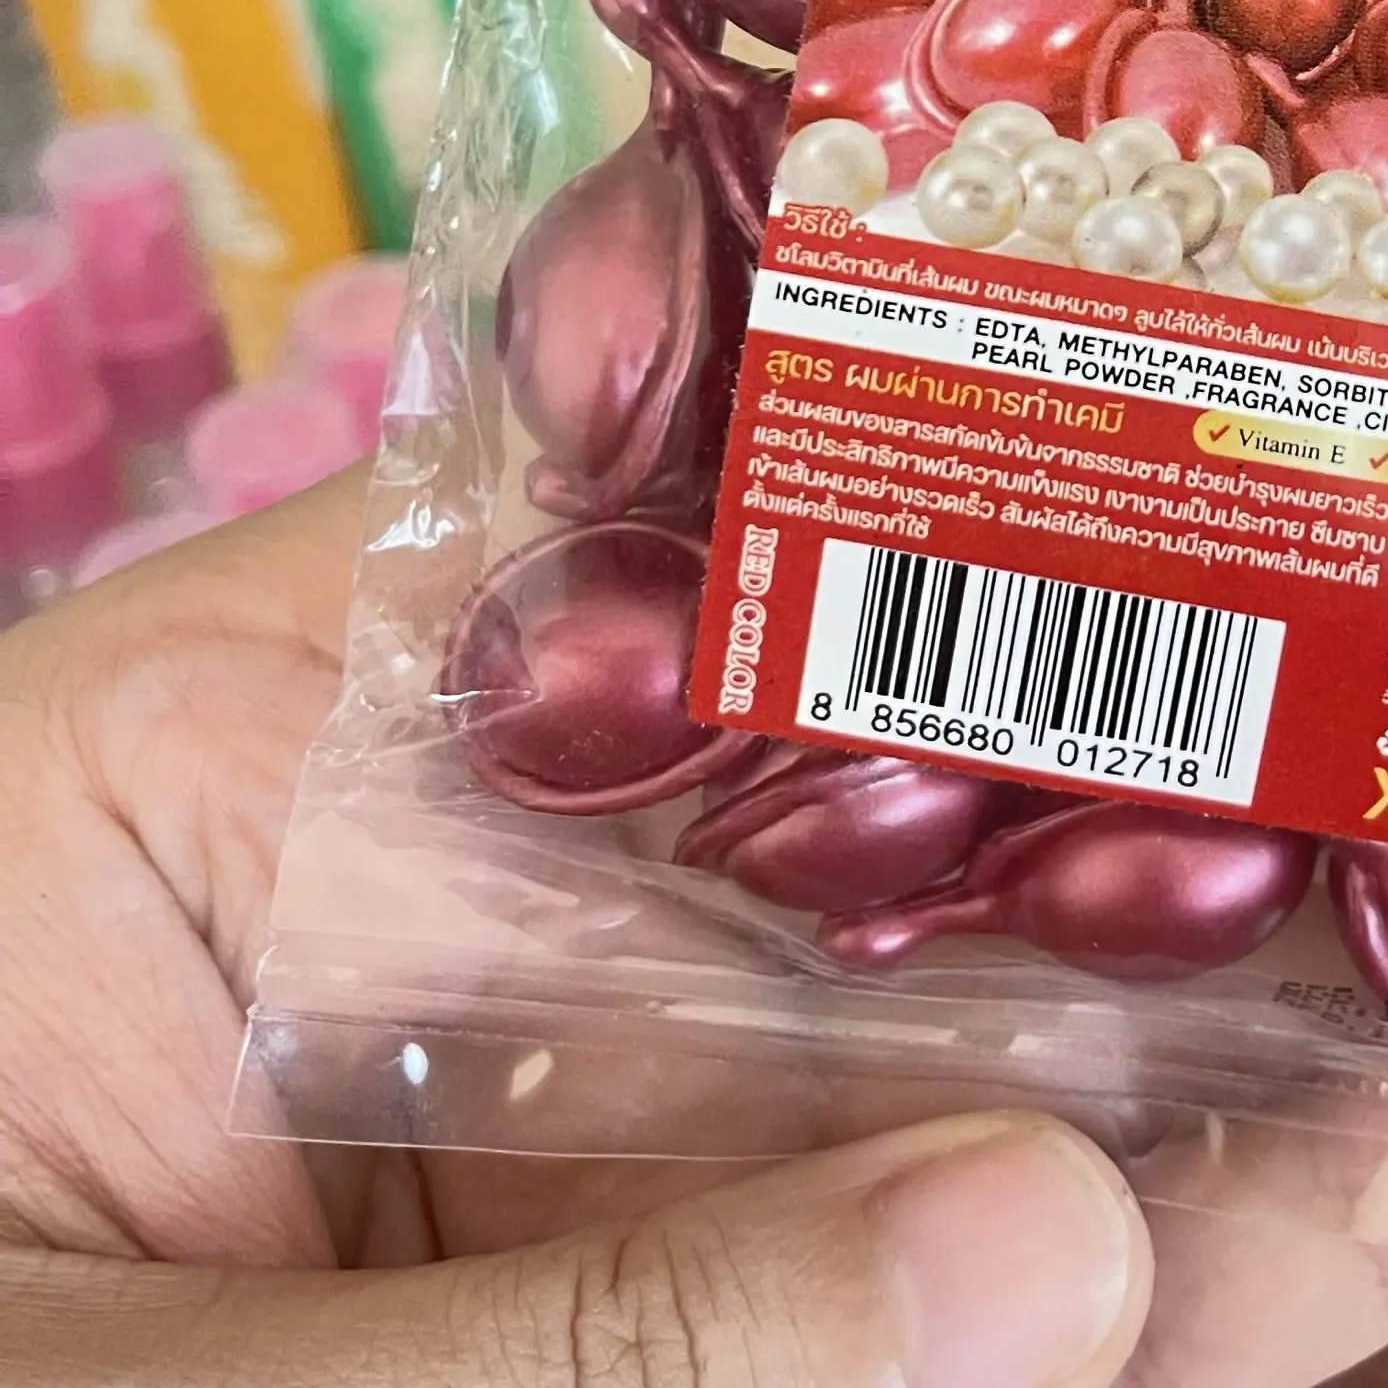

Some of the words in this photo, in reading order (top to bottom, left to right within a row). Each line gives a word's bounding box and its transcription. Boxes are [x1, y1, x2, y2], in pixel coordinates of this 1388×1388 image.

[781, 199, 852, 238] วิธีใช้
[776, 242, 979, 295] ชโลมวิตามินที่เส้นผม
[776, 283, 947, 328] INGREDIENTS
[976, 318, 1048, 350] EDTA,
[1059, 332, 1288, 393] METHYLPARABEN,
[972, 342, 1052, 373] PEARL
[1065, 359, 1175, 394] POWDER
[766, 350, 833, 383] สูตร
[845, 347, 1124, 433] ผมผ่านการทำเคมี
[1240, 429, 1319, 459] Vitamin
[1331, 445, 1345, 464] E
[737, 525, 779, 596] RED
[719, 599, 767, 713] COLOR
[810, 693, 832, 721] 8
[870, 703, 1013, 755] 856680
[1057, 739, 1198, 787] 012718
